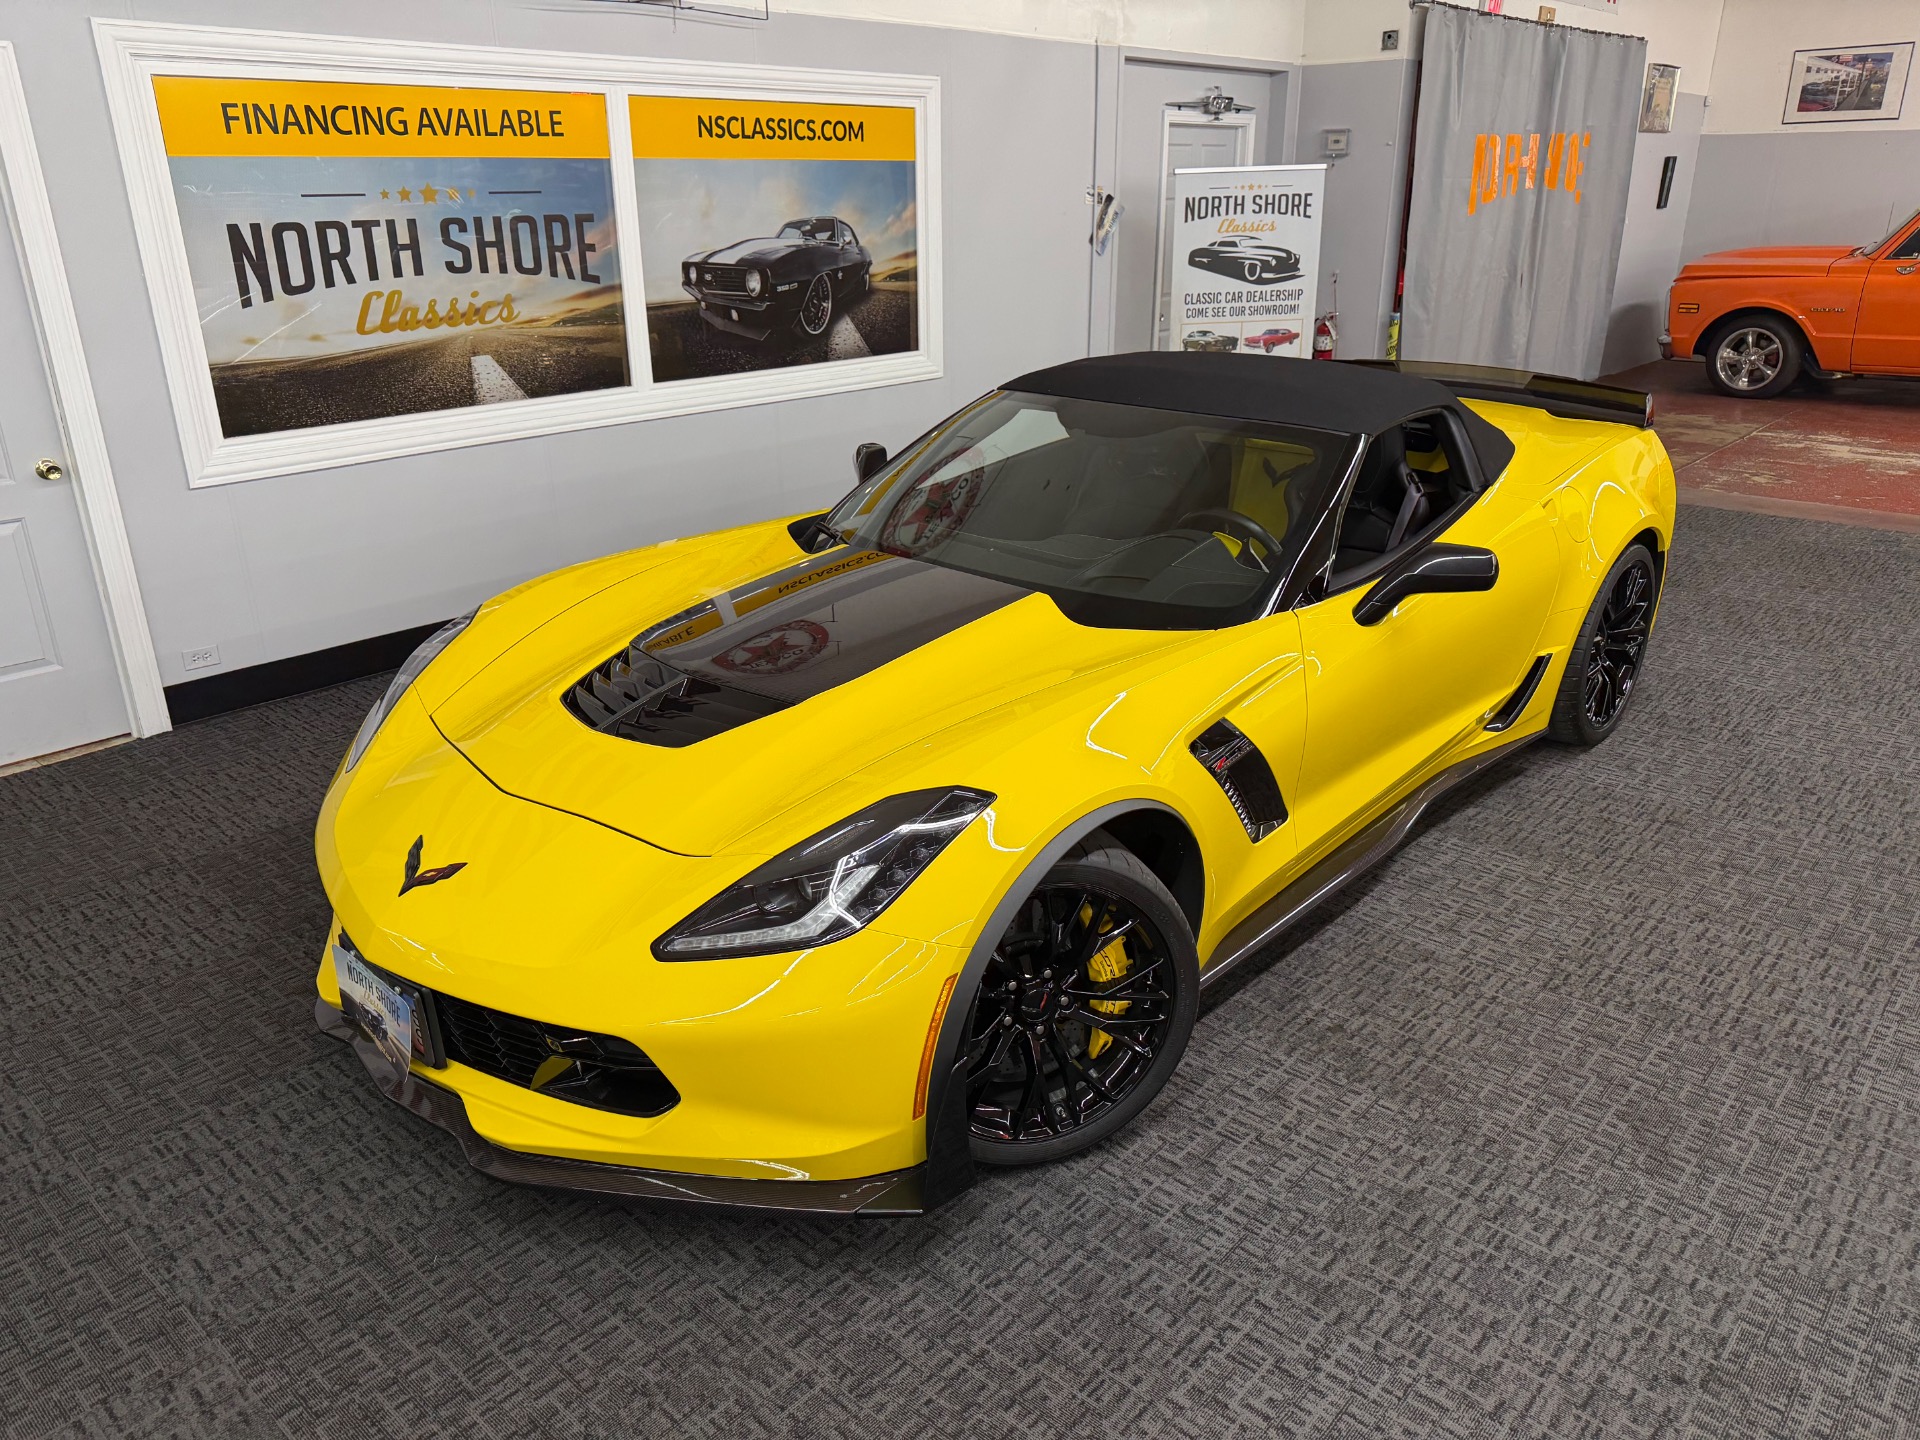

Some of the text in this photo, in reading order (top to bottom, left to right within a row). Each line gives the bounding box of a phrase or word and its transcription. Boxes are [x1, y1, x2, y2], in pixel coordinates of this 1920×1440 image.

[220, 102, 565, 138] FINANCING AVAILABLE
[697, 114, 865, 143] NSCLASSICS.COM
[1184, 193, 1313, 223] NORTH SHORE
[1217, 218, 1277, 234] Classics
[226, 213, 601, 309] NORTH SHORE
[1184, 288, 1304, 306] CLASSIC CAR DEALERSHIP
[1185, 303, 1300, 319] COME SEE OUR SHOWROOM!
[355, 289, 522, 337] Classics
[347, 962, 374, 996] NORTH
[376, 987, 401, 1028] SHORE
